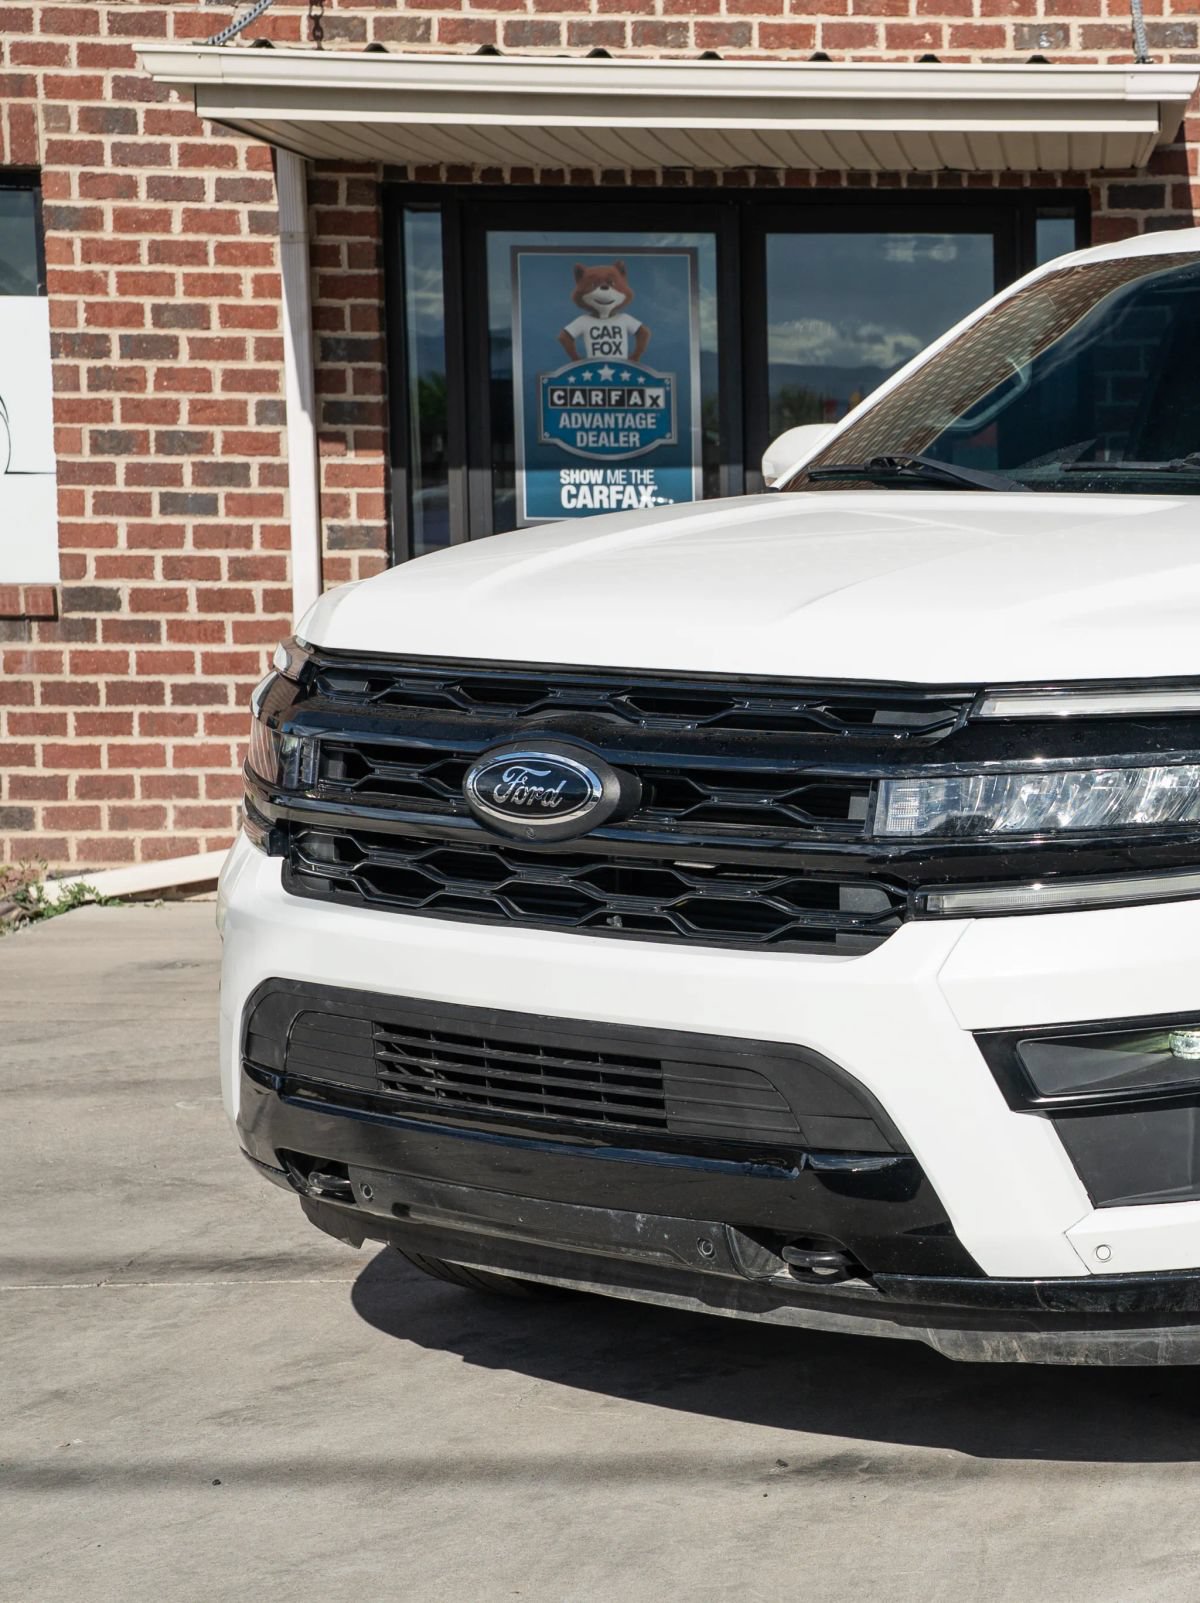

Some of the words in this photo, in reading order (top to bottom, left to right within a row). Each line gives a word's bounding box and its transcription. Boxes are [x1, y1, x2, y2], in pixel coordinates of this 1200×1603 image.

[590, 326, 623, 340] CAR
[591, 341, 623, 356] FOX
[552, 390, 661, 408] CARFAX
[559, 412, 657, 429] ADVANTAGE
[576, 430, 641, 447] DEALER
[560, 469, 603, 484] SHOW
[606, 469, 627, 484] ME
[629, 469, 655, 484] THE
[561, 484, 655, 509] CARFAX
[492, 765, 568, 808] Ford
